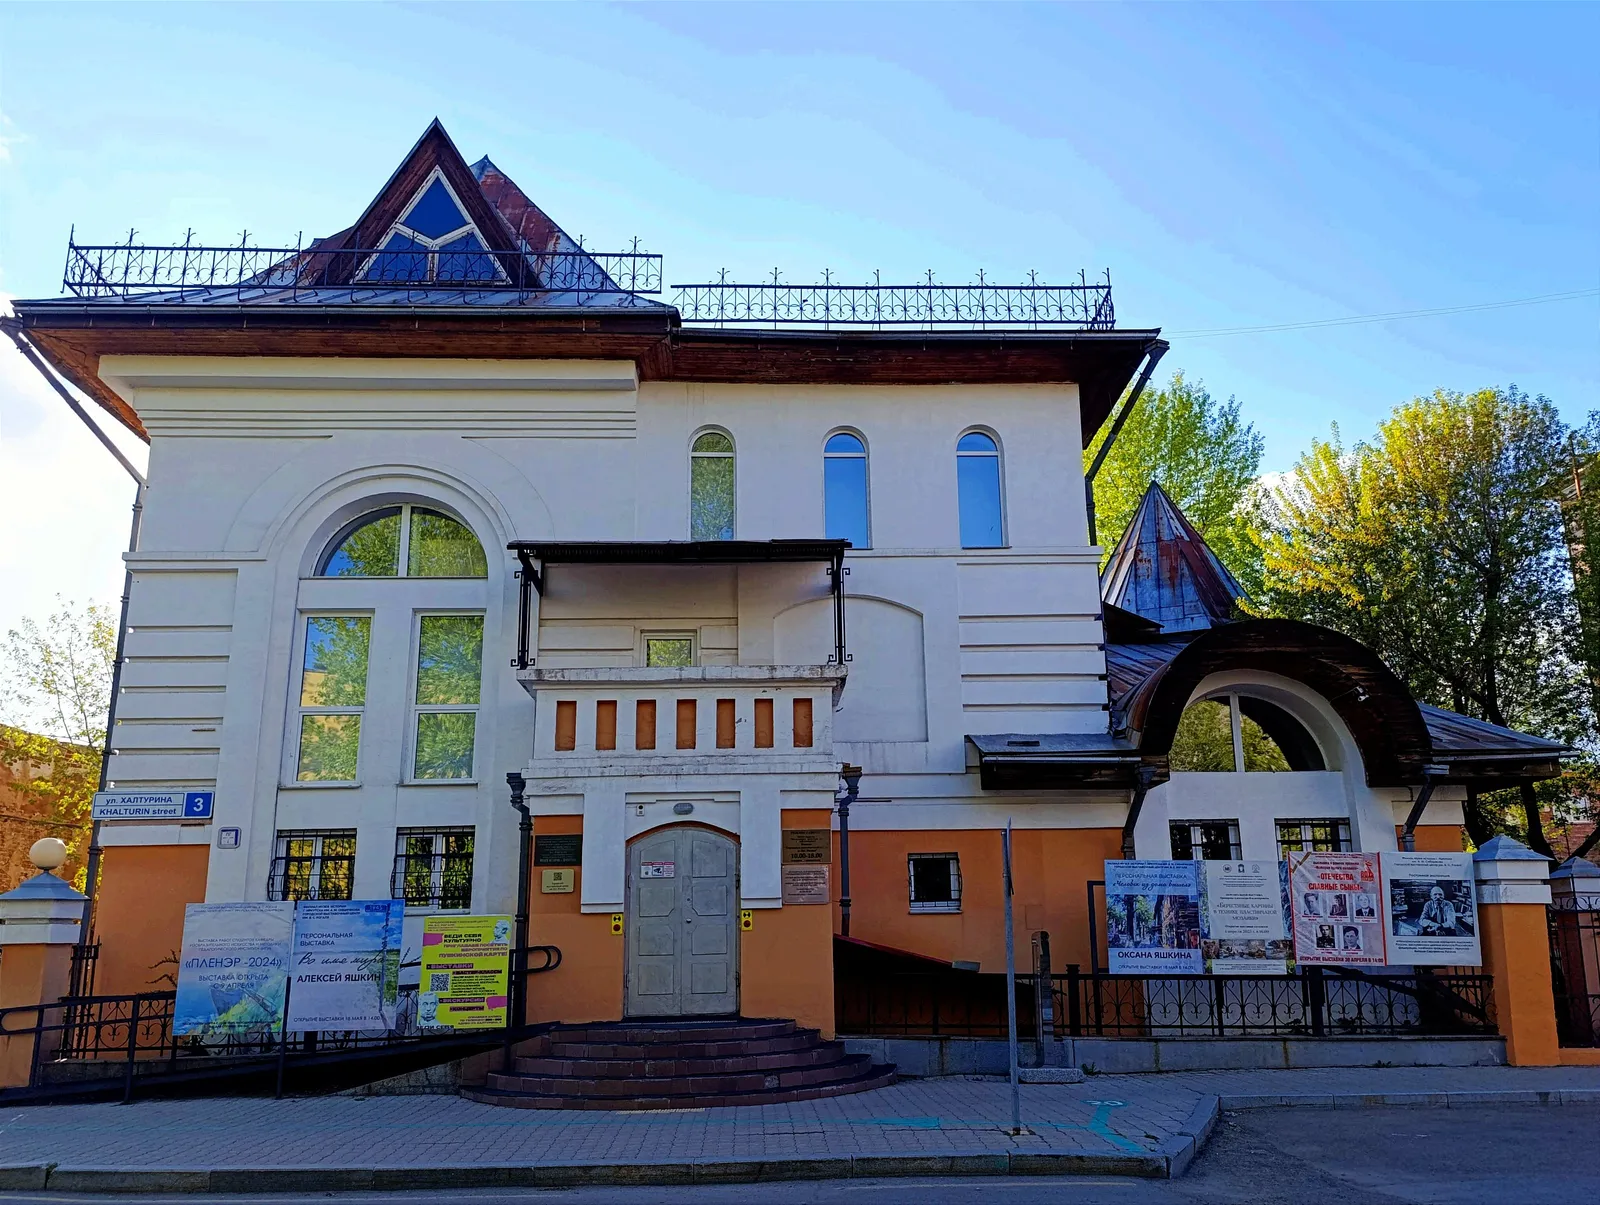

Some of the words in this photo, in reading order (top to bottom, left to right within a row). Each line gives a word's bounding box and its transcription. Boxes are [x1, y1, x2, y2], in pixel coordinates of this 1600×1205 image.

[105, 798, 118, 806] ул.
[120, 796, 173, 804] ХАЛТУРИНА
[193, 797, 204, 812] 3
[99, 808, 150, 816] KHALTURIN
[1308, 883, 1338, 891] СЛАВНЫЕ
[1117, 951, 1152, 959] ОКСАНА
[1154, 951, 1192, 959] ЯШКИНА
[185, 957, 241, 969] «ПЛЕНЭР
[198, 973, 235, 982] ВЫСТАВКА
[237, 973, 269, 981] ОТКРЫТА
[296, 972, 342, 983] АЛЕКСЕЙ
[344, 973, 381, 982] ЯШКИН
